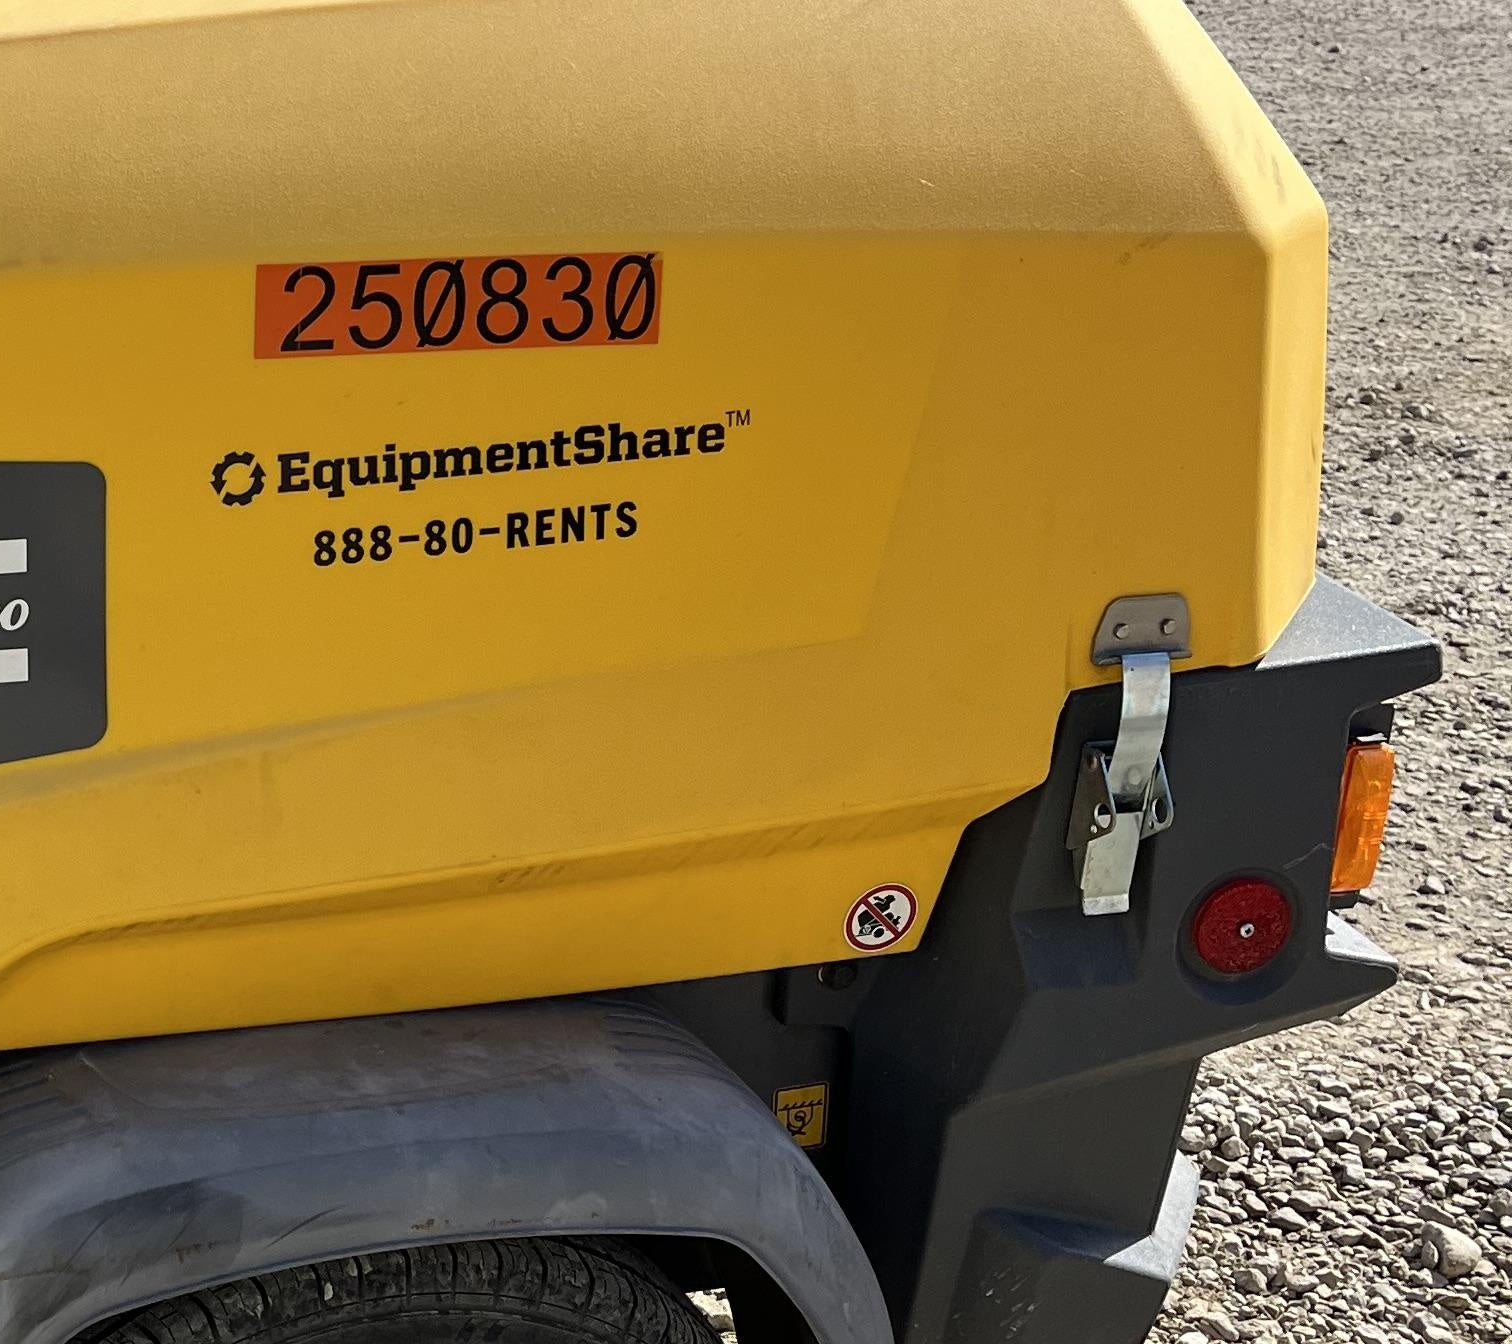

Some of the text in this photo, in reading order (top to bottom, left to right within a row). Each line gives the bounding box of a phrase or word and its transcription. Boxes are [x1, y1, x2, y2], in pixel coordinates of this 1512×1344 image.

[279, 252, 657, 352] 250830
[277, 420, 726, 497] EquipmentShare
[313, 501, 638, 567] 888-80-RENTS
